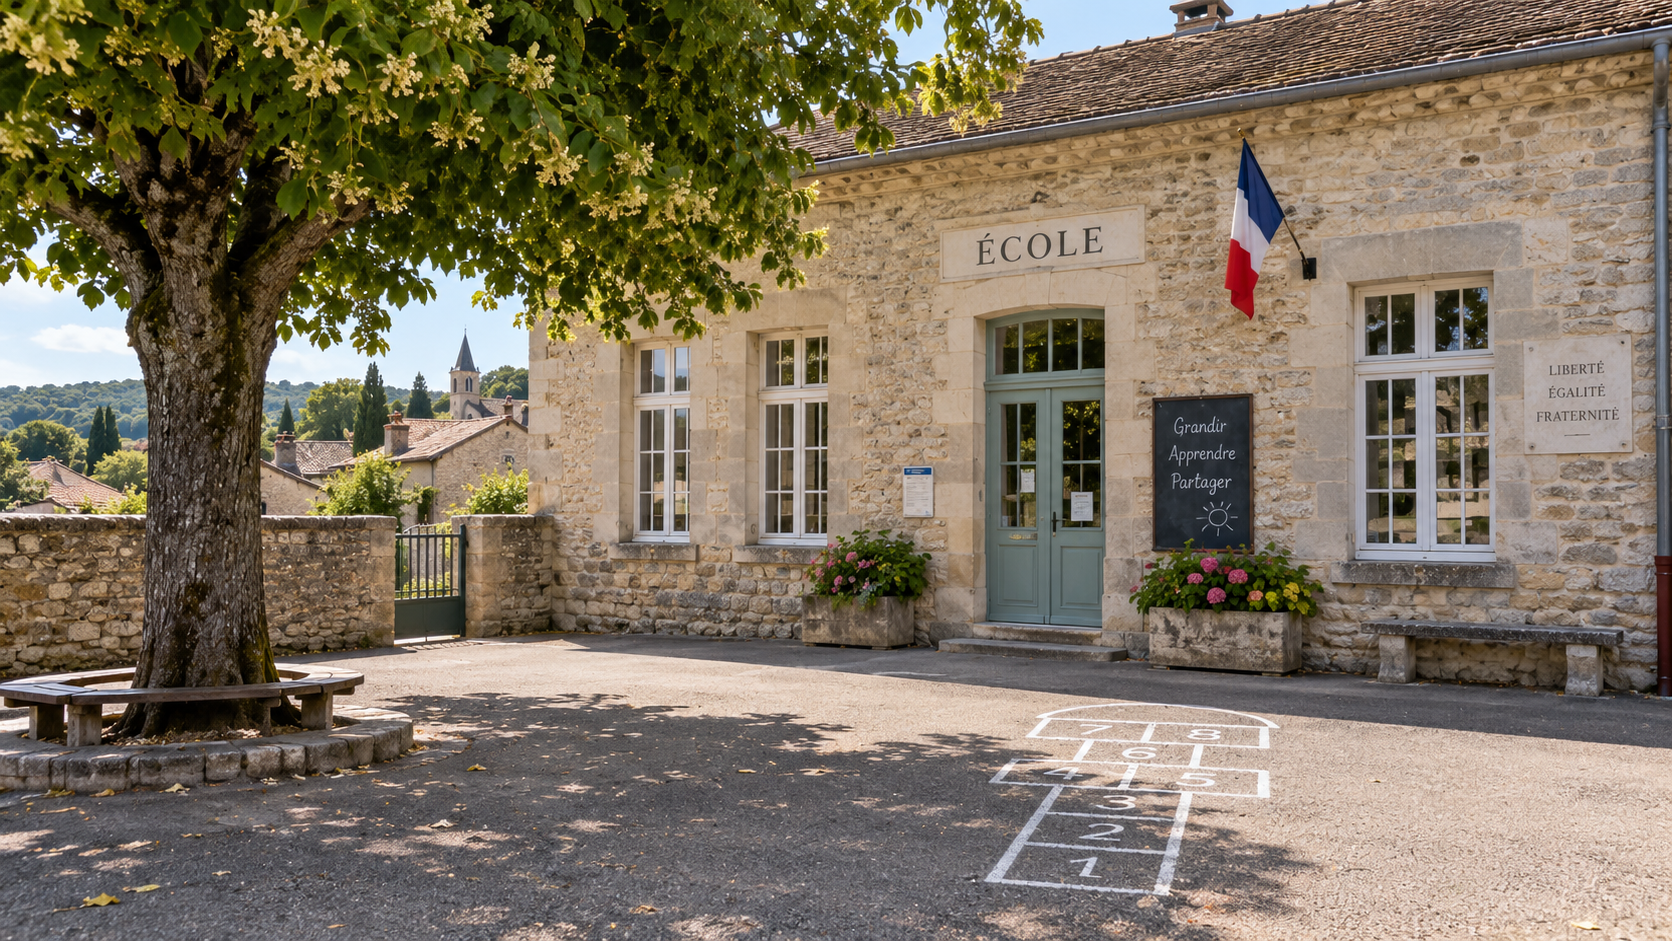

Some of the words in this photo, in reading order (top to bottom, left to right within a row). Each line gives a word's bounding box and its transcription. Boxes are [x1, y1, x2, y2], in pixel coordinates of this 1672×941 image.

[976, 226, 1103, 266] ÉCOLE
[1549, 360, 1605, 376] LIBERTÉ
[1548, 383, 1606, 399] ÉGALITÉ
[1536, 407, 1620, 422] FRATERNITÉ
[1173, 416, 1227, 437] Grandir
[1168, 444, 1236, 466] Apprendre
[1171, 472, 1232, 495] Partager
[1079, 723, 1113, 735] 7
[1187, 728, 1221, 740] 8
[1121, 747, 1157, 760] 6
[1043, 766, 1083, 780] 4
[1176, 772, 1215, 787] 5
[1095, 795, 1136, 810] 3
[1078, 823, 1124, 841] 2
[1069, 856, 1102, 878] 1
